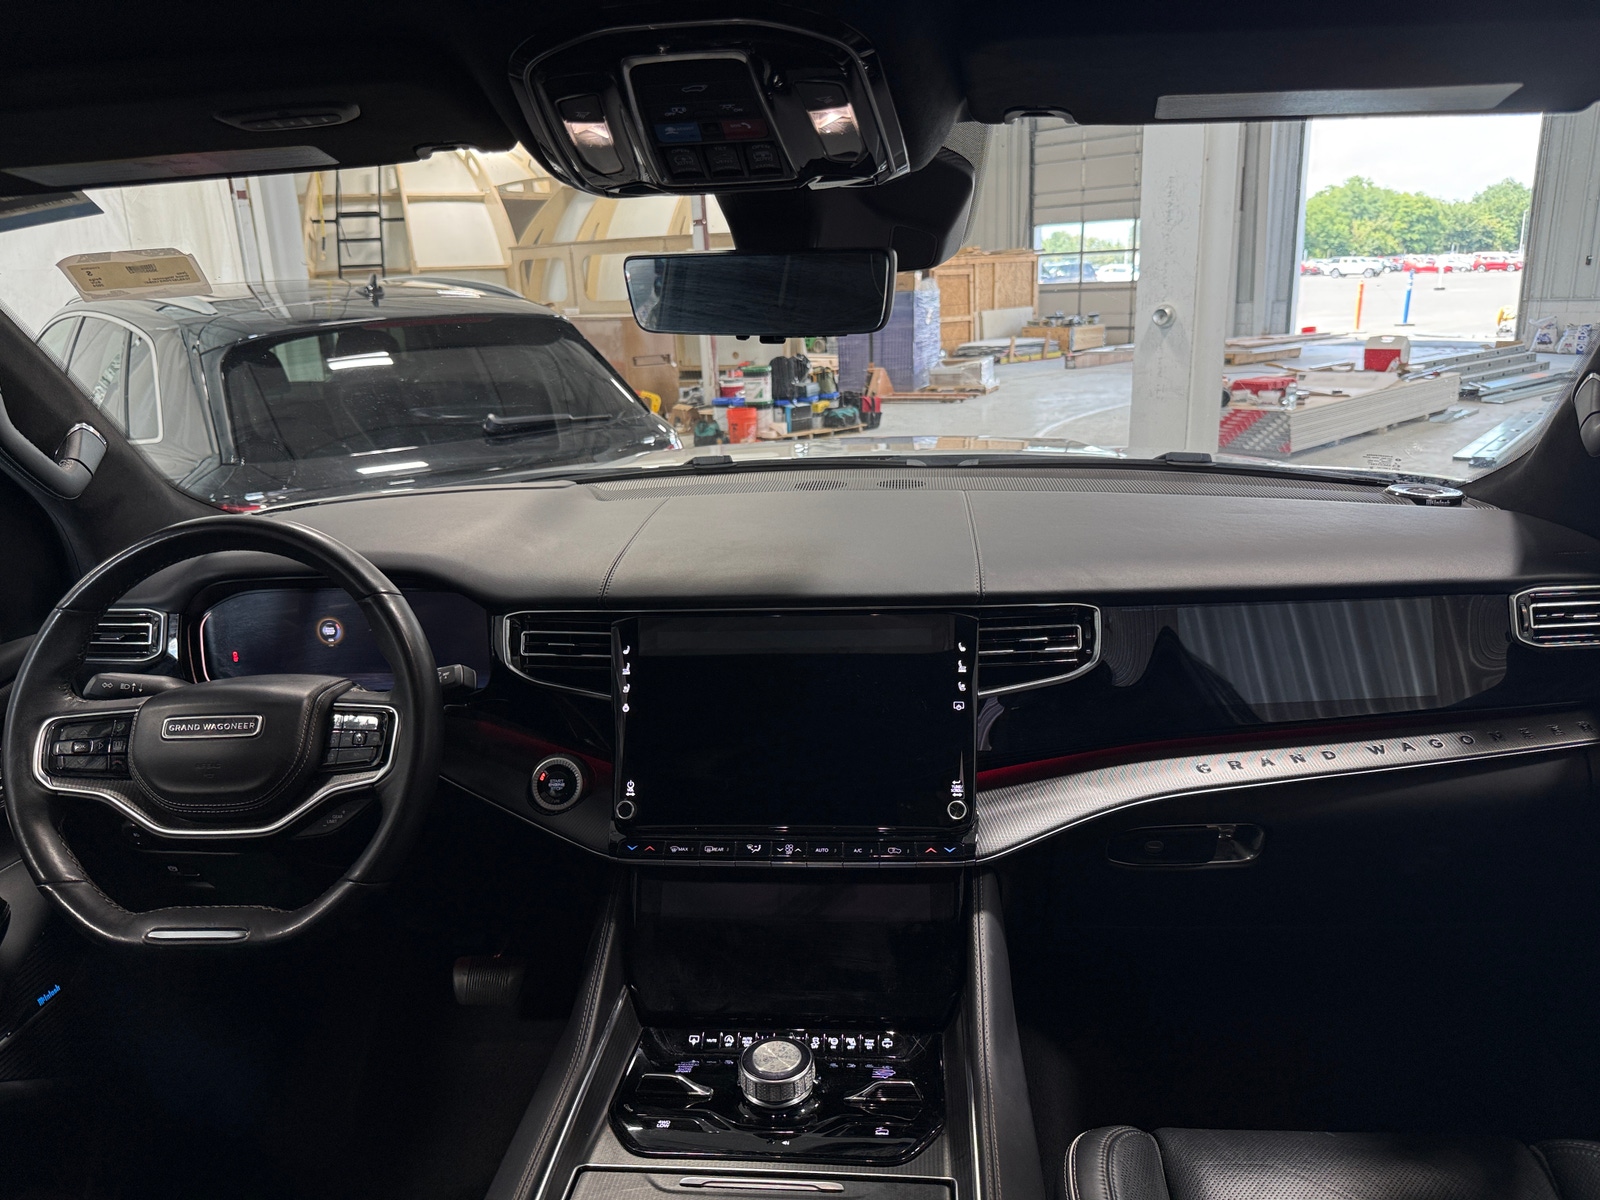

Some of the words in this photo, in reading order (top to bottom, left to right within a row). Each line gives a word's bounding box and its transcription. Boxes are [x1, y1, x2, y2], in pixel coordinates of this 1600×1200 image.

[168, 723, 200, 732] GRAND
[203, 721, 256, 731] WAGONEER
[1196, 750, 1337, 775] GRAND
[1364, 720, 1597, 757] WAGONEER
